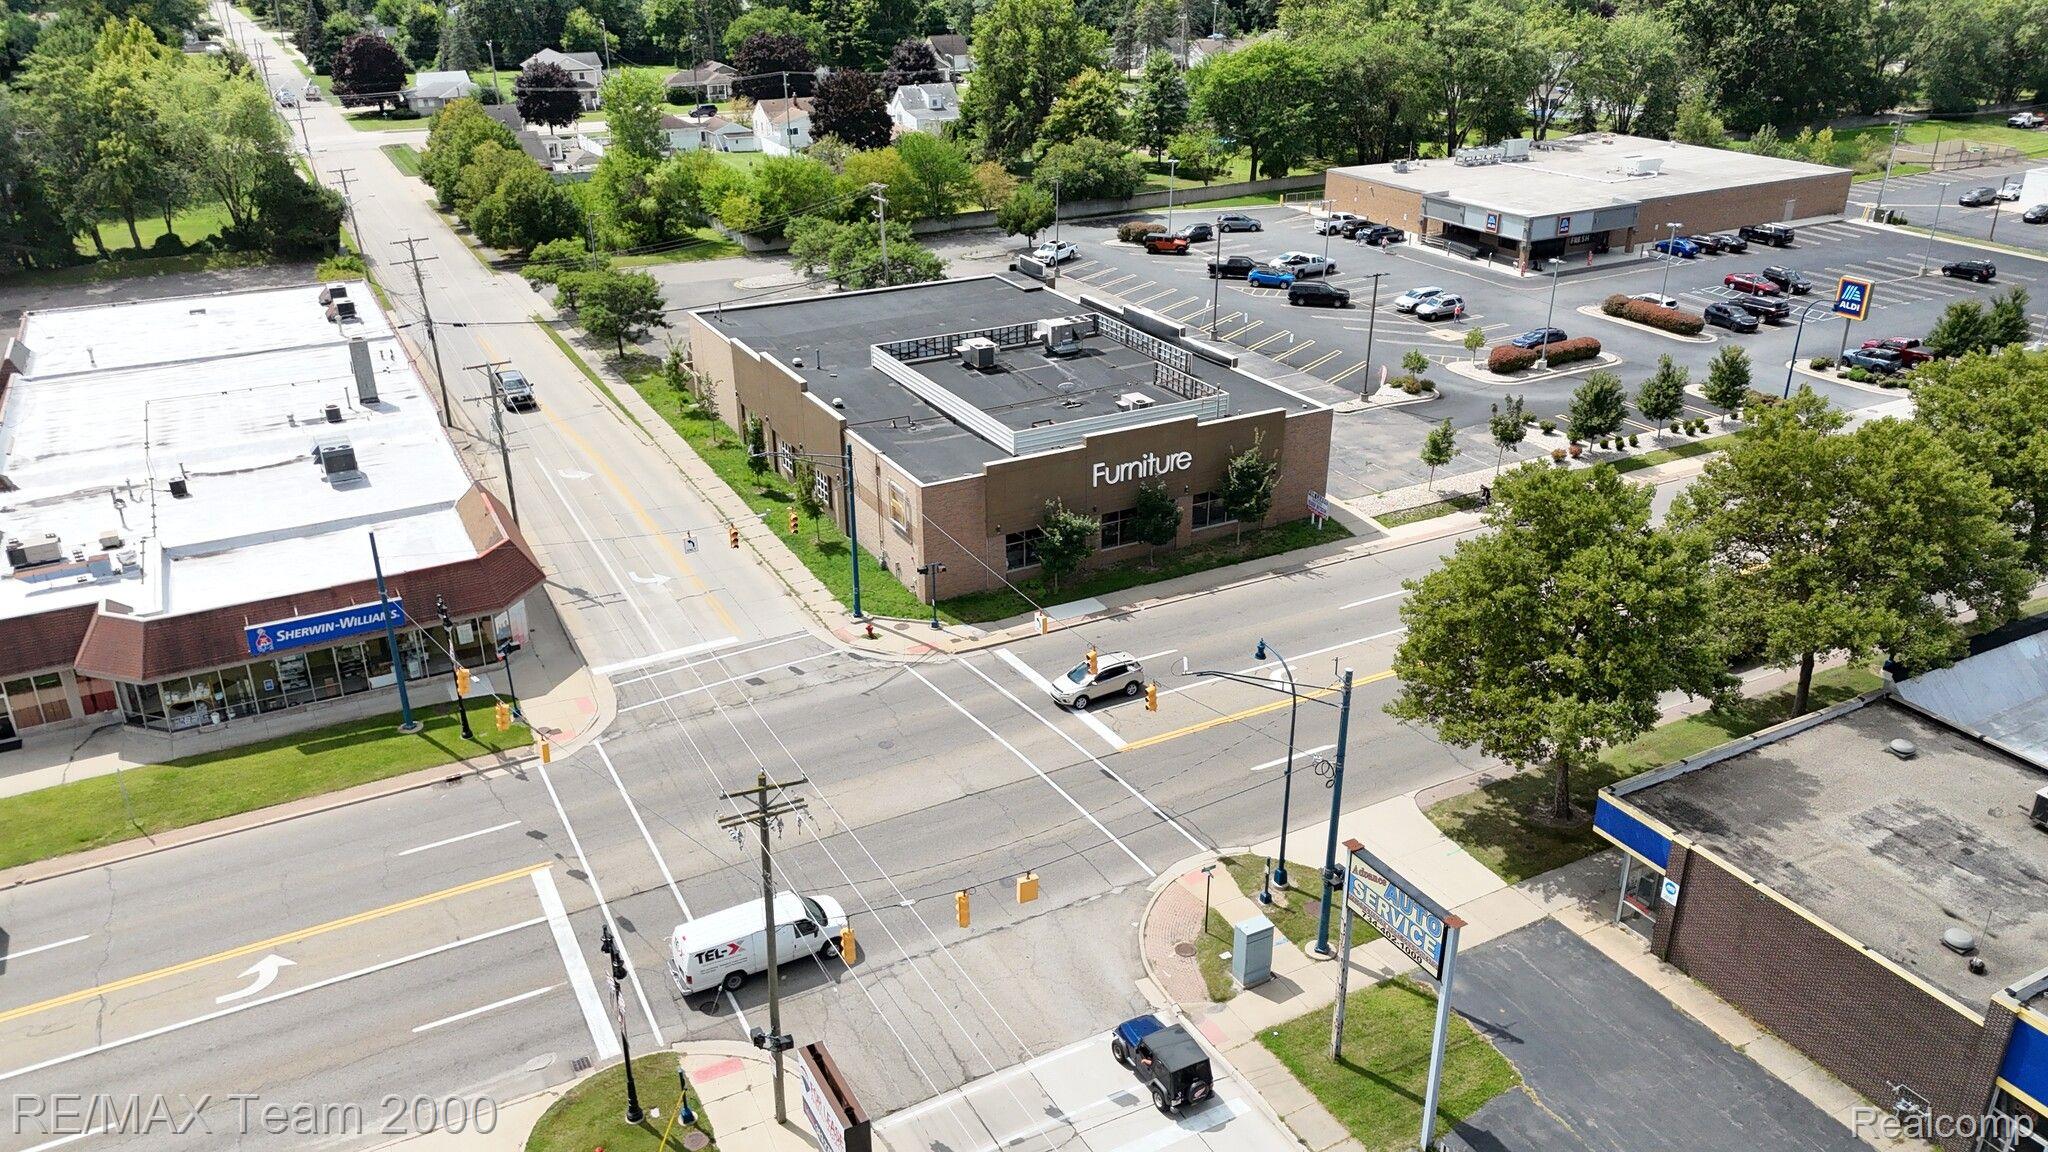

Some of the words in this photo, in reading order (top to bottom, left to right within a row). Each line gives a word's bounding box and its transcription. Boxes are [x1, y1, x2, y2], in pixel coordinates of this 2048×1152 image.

[1840, 301, 1860, 311] ALDI
[1093, 451, 1193, 488] Furniture
[1353, 879, 1437, 959] SERVICE
[1384, 883, 1442, 938] AUTO
[1361, 911, 1423, 964] 734-402-1000
